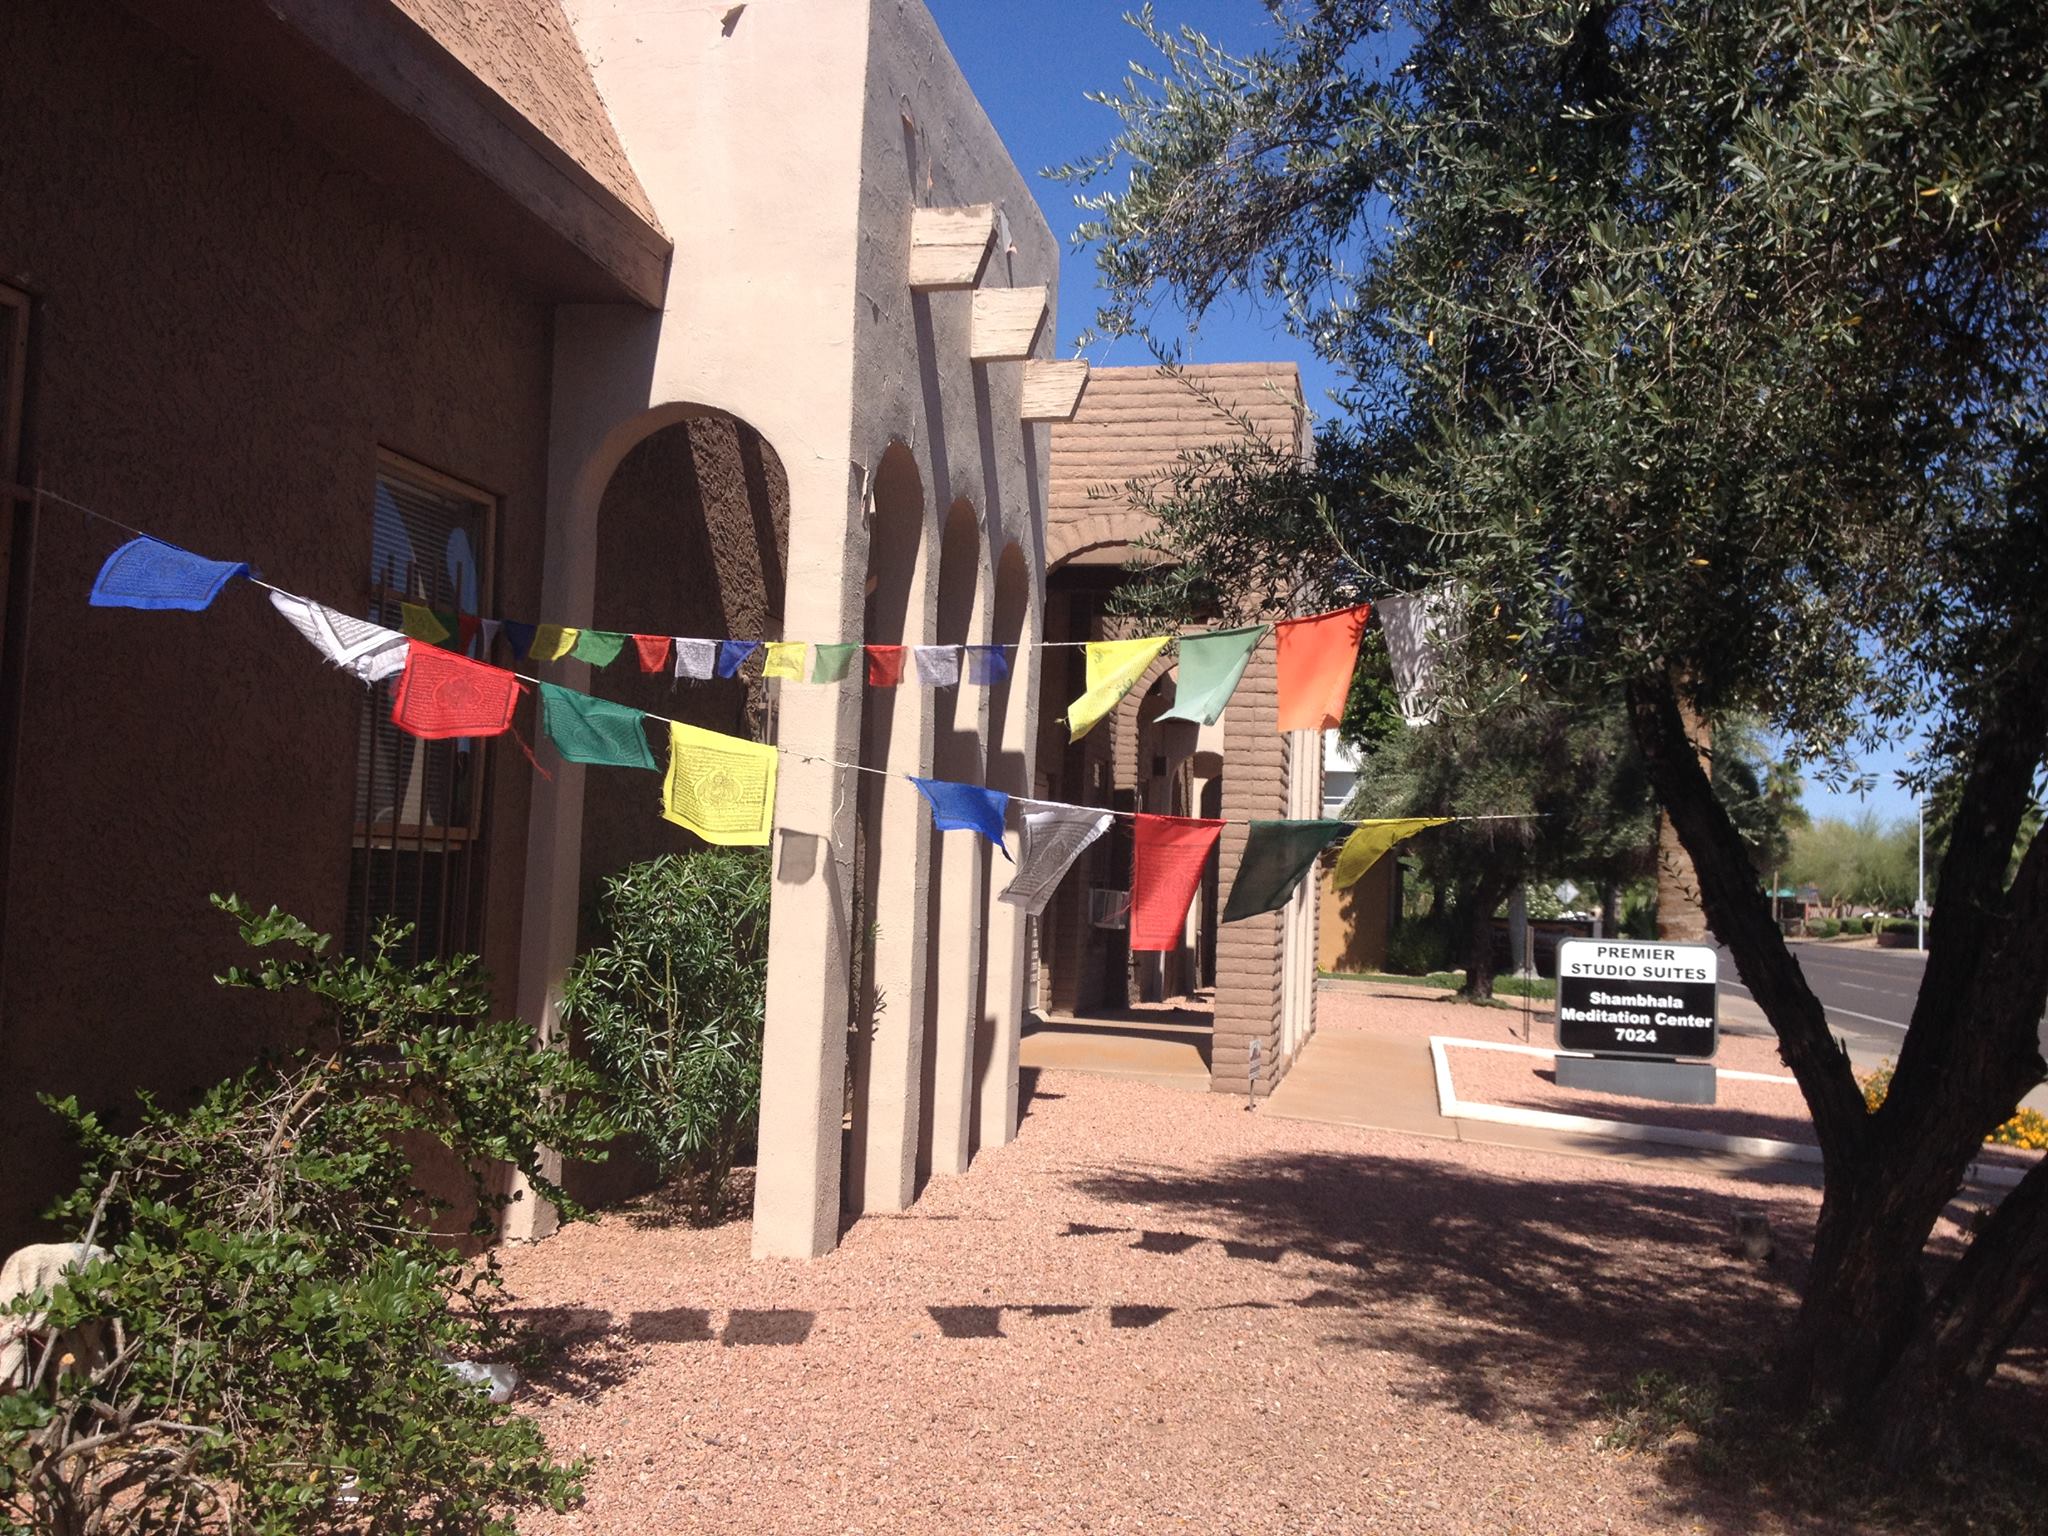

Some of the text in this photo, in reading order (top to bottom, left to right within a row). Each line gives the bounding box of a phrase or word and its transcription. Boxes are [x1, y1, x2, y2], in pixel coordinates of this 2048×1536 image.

[1597, 946, 1675, 961] PREMIER
[1571, 963, 1706, 980] STUDIO SUITES
[1589, 991, 1684, 1009] Shambhala
[1561, 1007, 1713, 1028] Meditation Center
[1615, 1028, 1657, 1043] 7024
